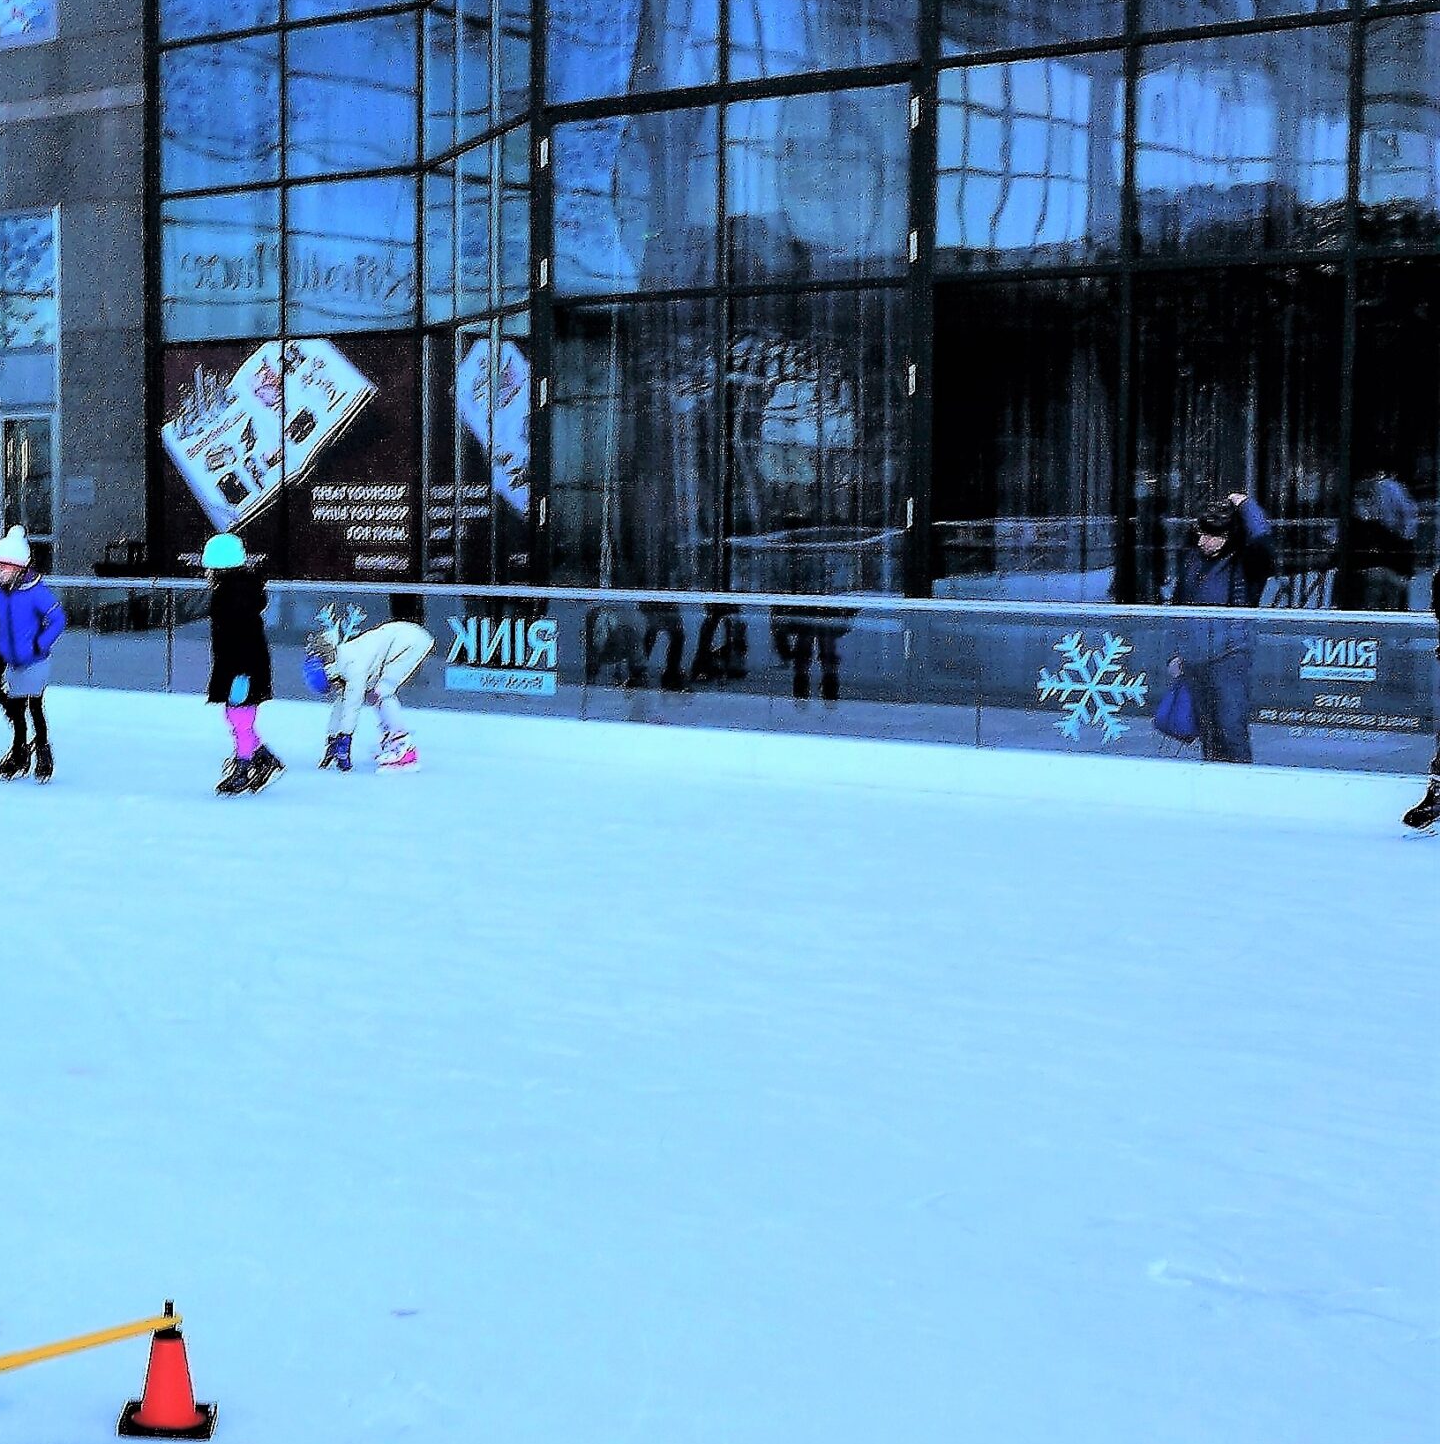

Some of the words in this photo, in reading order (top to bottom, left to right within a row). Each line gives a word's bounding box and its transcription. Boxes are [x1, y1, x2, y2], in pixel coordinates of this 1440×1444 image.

[311, 485, 347, 500] TREAT
[312, 505, 349, 521] WHILE
[350, 505, 375, 520] YOU
[375, 505, 409, 520] SHOP
[346, 525, 371, 540] FOR
